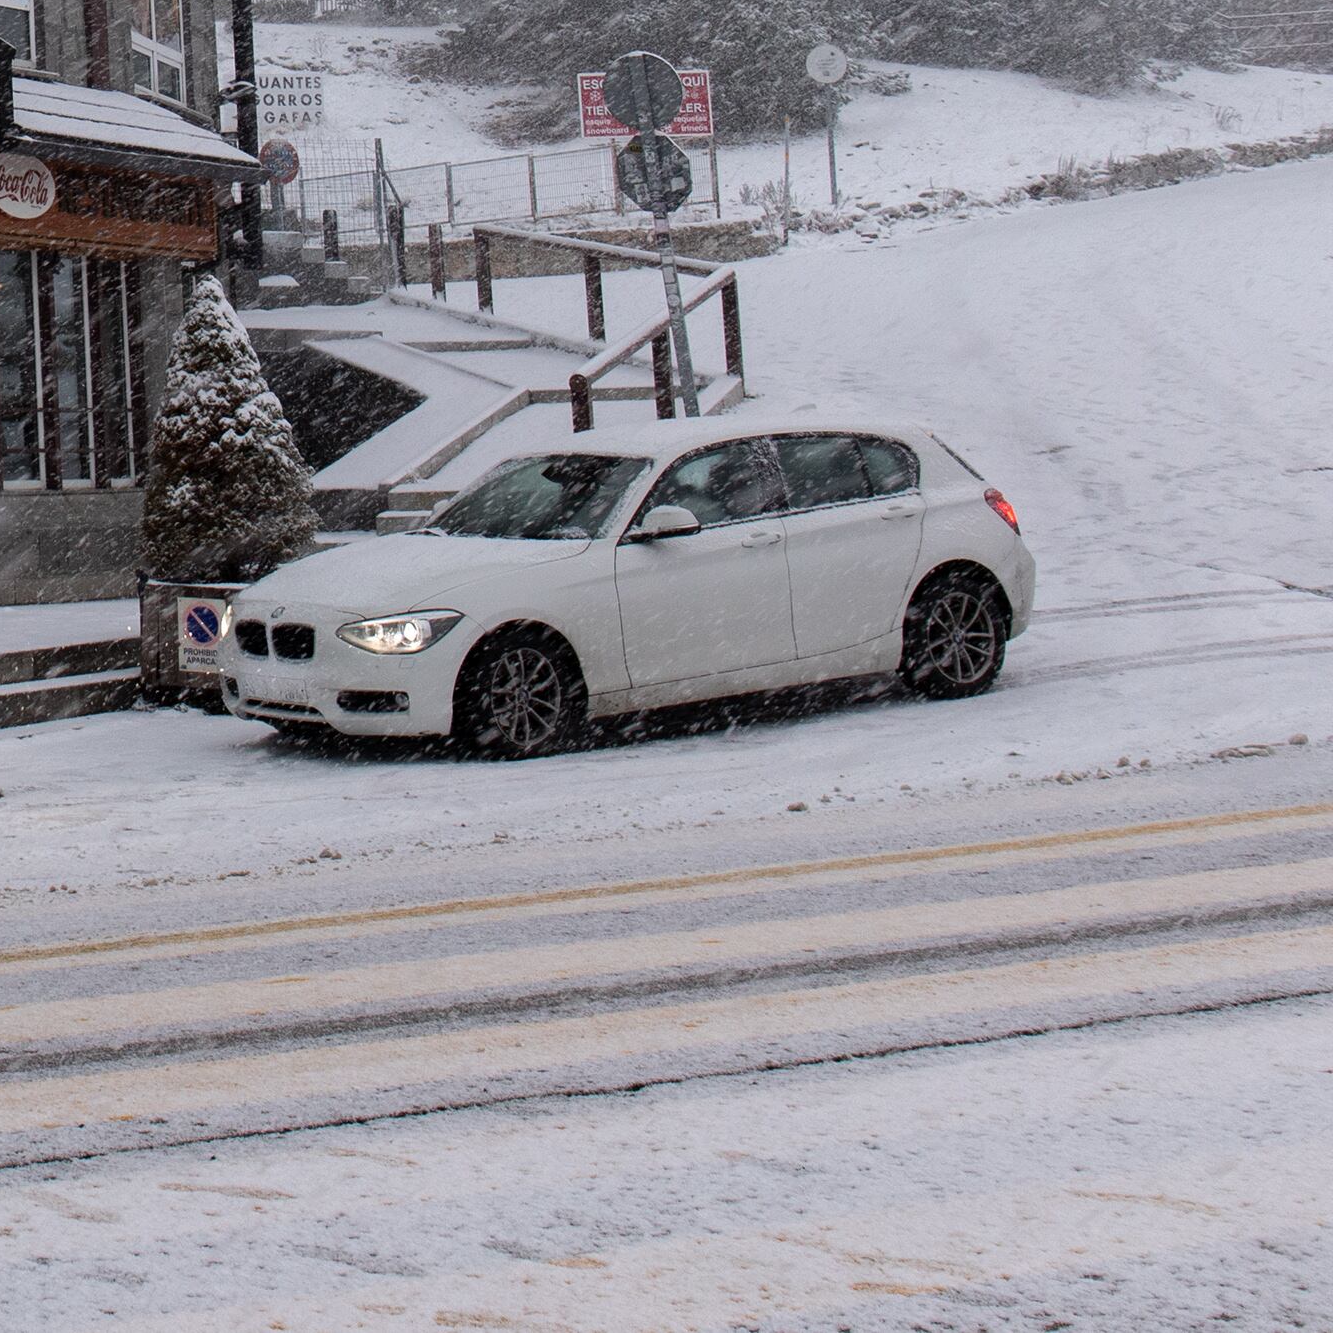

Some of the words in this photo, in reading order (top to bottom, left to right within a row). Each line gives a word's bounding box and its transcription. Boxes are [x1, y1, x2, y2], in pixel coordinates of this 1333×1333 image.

[255, 76, 322, 89] UANTES
[682, 74, 705, 88] QUÍ
[679, 102, 706, 113] LER:
[264, 110, 323, 126] GAFAS
[183, 647, 219, 657] PROHIBID
[186, 656, 217, 666] APARCA
